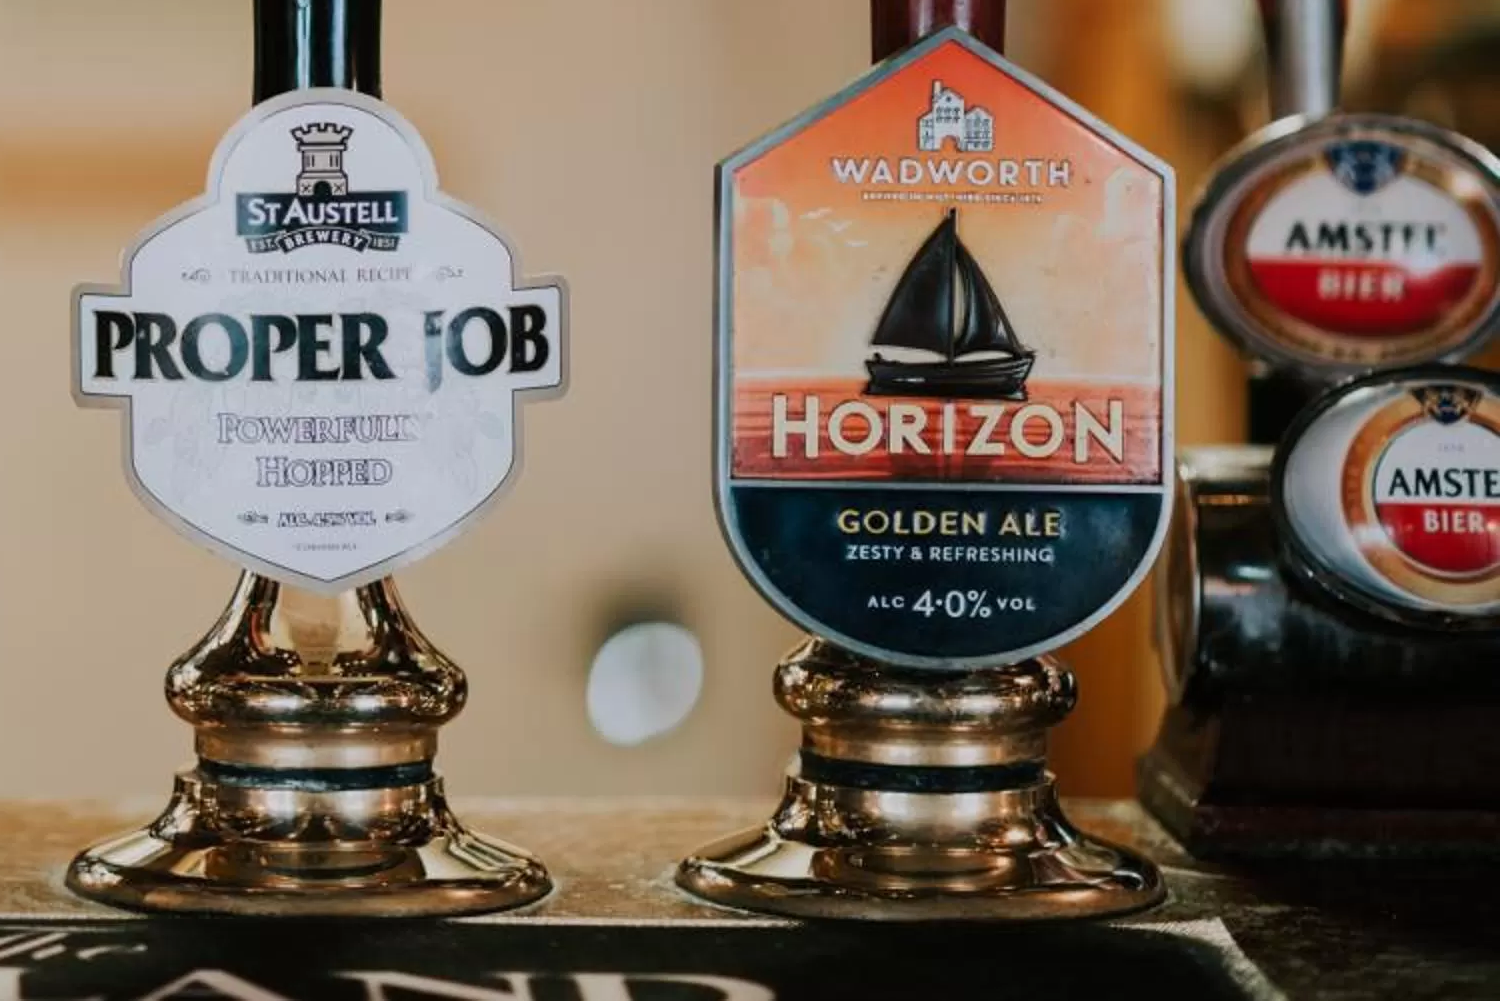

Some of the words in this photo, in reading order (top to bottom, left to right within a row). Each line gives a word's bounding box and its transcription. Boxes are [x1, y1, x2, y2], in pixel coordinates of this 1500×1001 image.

[831, 157, 1072, 187] WADWORTH
[284, 229, 363, 250] BREWERY
[92, 309, 397, 383] PROPER
[422, 304, 550, 394] JOB
[771, 393, 1125, 464] HORIZON
[837, 507, 987, 536] GOLDEN
[998, 511, 1063, 537] ALE
[1423, 508, 1486, 534] BIER
[845, 545, 905, 561] ZESTY
[910, 546, 923, 561] &
[929, 546, 1055, 563] REFRESHING
[867, 595, 905, 609] ALC
[997, 597, 1037, 611] VOL
